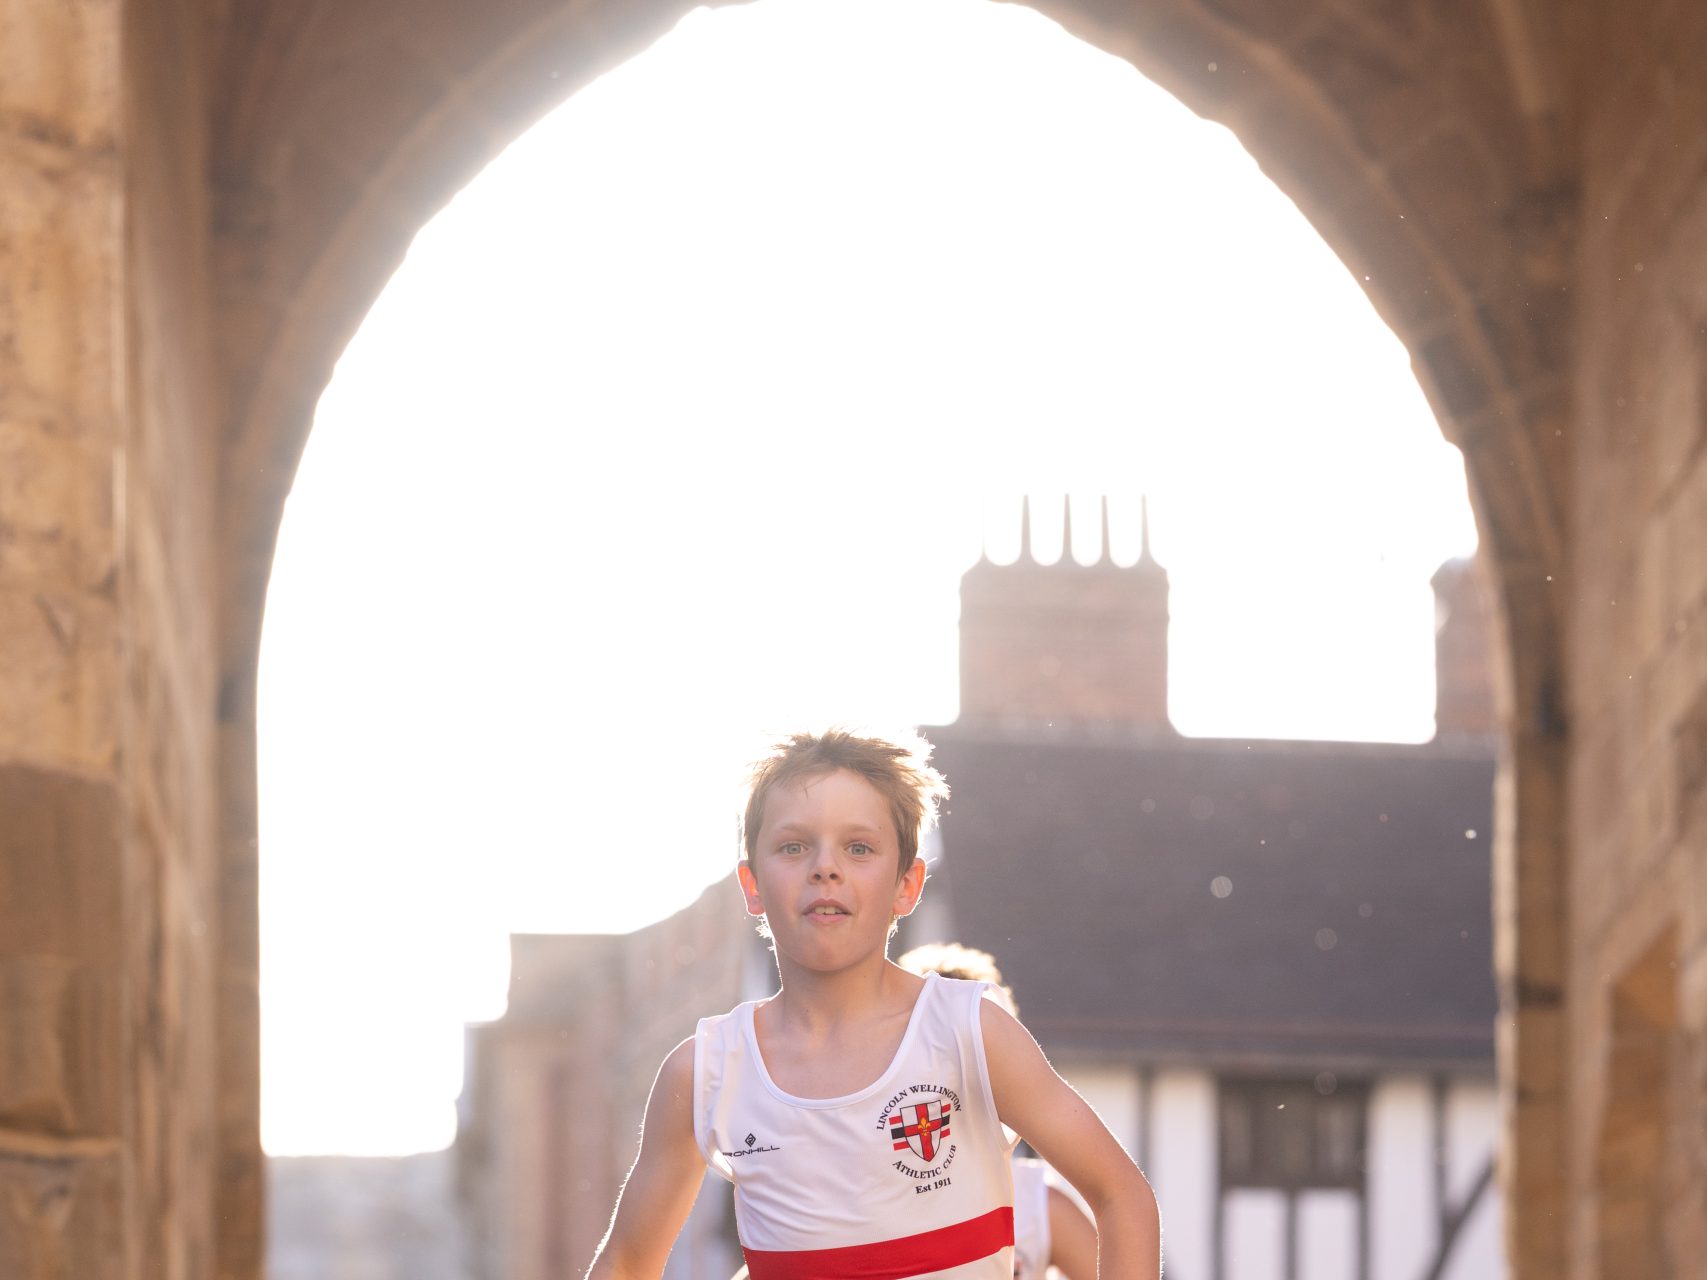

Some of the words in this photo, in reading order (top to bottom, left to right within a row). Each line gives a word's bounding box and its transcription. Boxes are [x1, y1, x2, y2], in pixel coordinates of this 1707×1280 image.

[877, 1090, 908, 1130] LINCOLN
[909, 1084, 961, 1112] WELLINGTON
[893, 1160, 942, 1179] ATHLETIC
[943, 1144, 957, 1169] CLUB
[916, 1184, 932, 1194] Est
[934, 1177, 951, 1190] 1911
